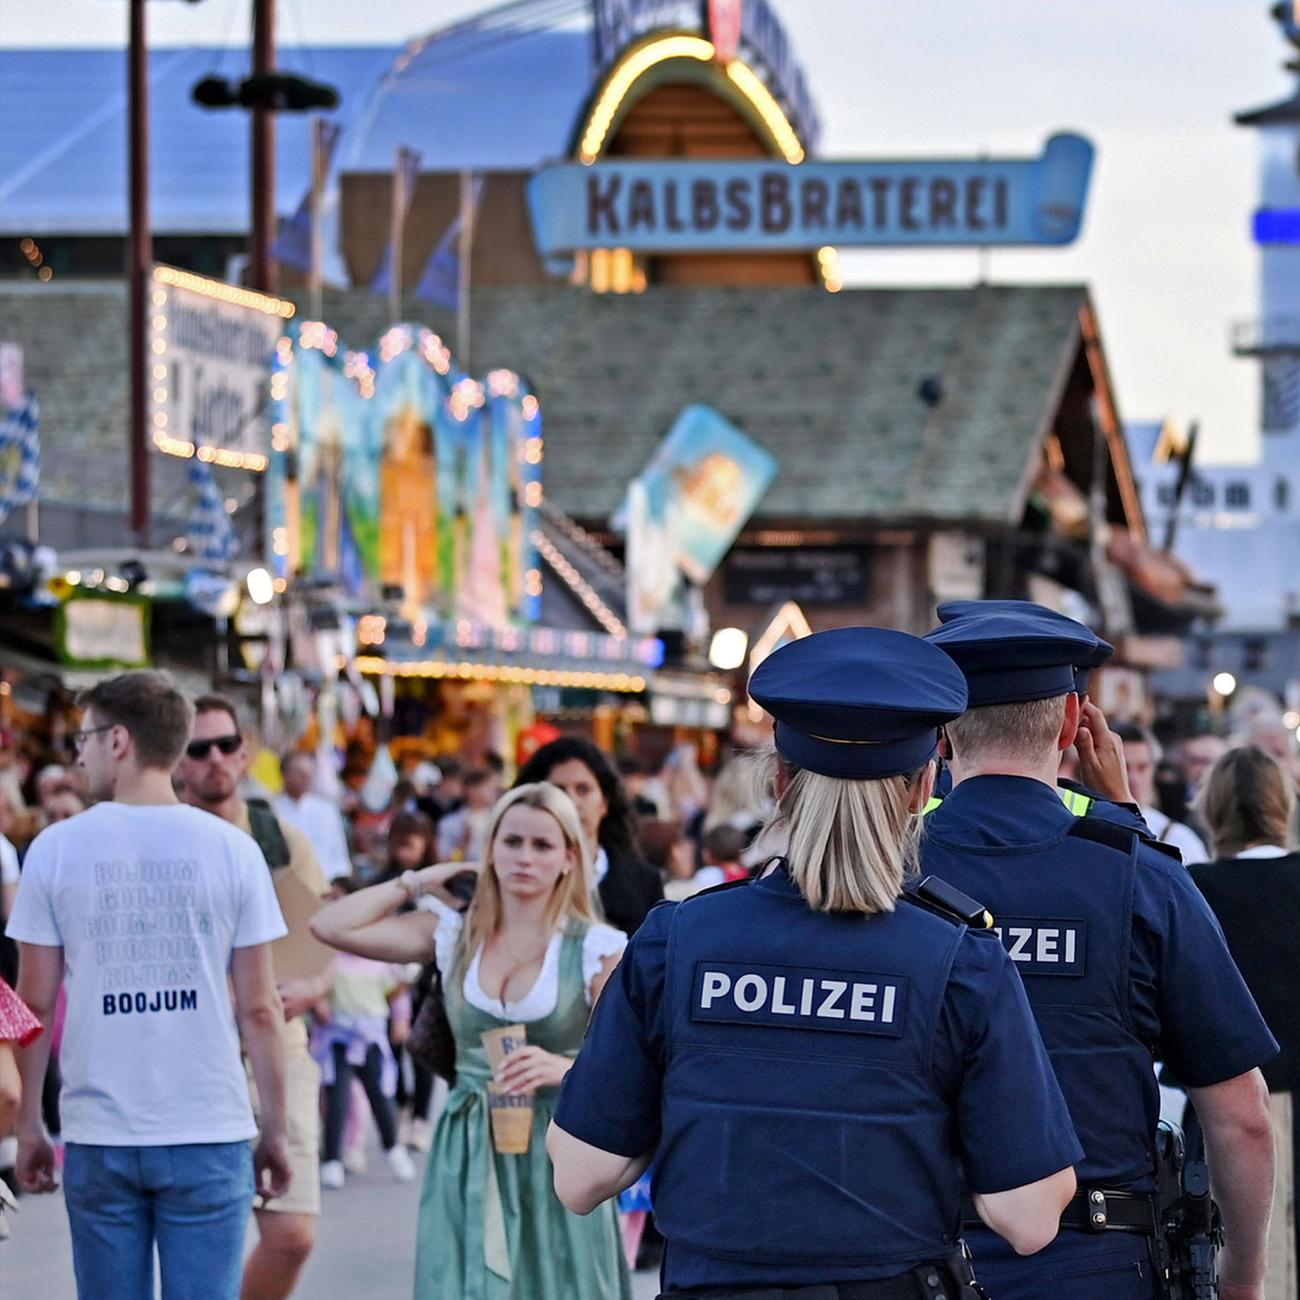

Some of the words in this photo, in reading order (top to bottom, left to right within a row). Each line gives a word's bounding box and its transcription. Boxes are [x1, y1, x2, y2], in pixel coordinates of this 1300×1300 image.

[994, 927, 1076, 963] ZEI
[103, 989, 197, 1015] BOOJUM
[701, 971, 896, 1023] POLIZEI
